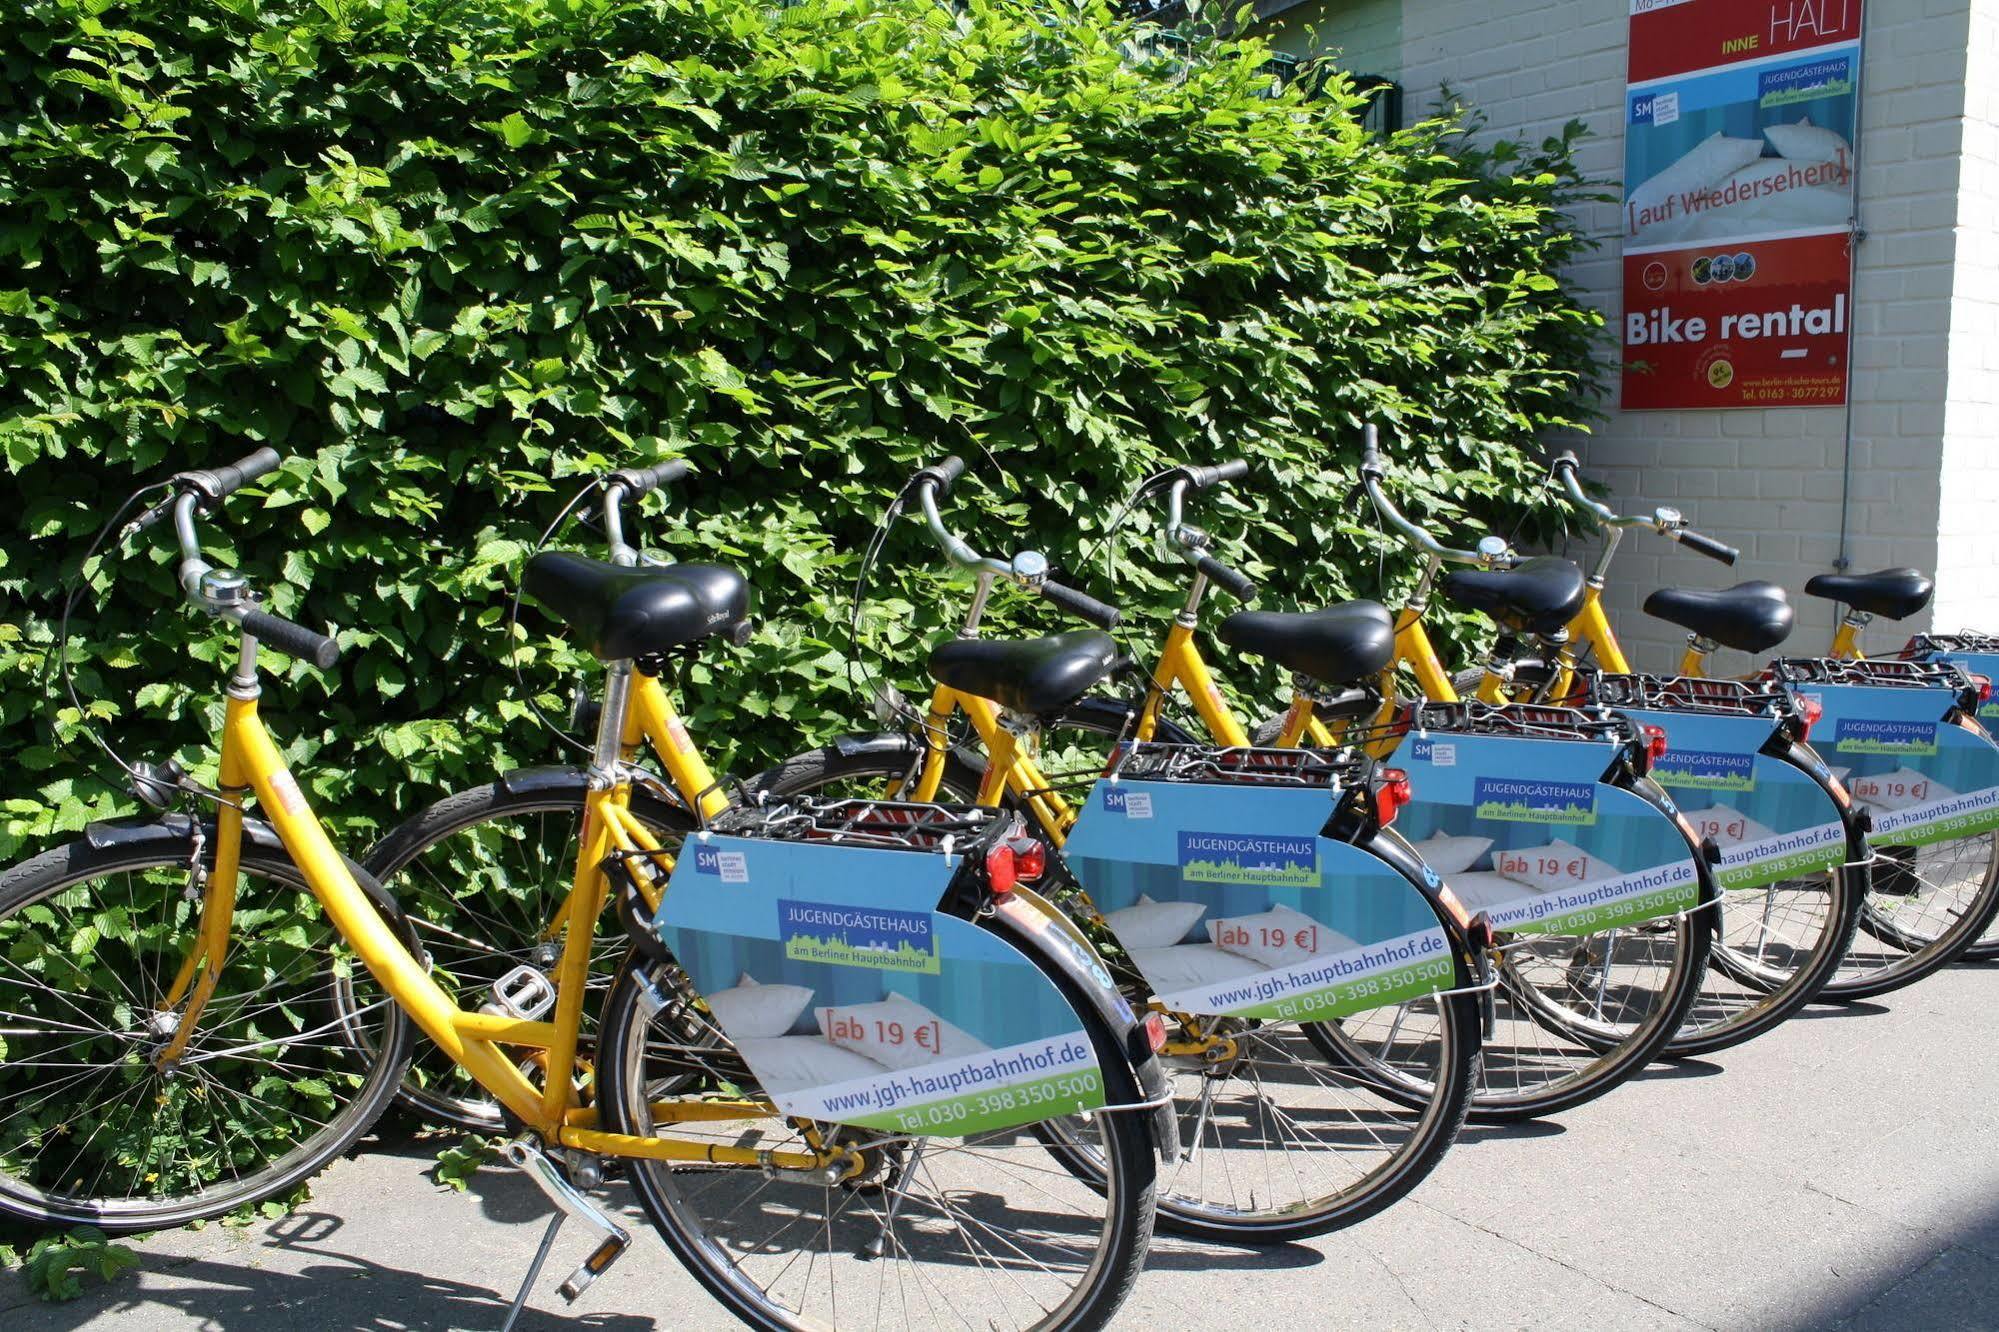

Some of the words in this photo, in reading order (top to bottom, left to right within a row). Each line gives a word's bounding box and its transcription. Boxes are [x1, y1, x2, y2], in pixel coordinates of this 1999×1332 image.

[1722, 35, 1759, 54] INNE
[1635, 101, 1651, 117] SM
[1629, 195, 1675, 236] [auf
[1681, 148, 1848, 214] Wiedersehen]
[1627, 307, 1706, 345] Bike
[1721, 294, 1845, 340] rental
[1742, 389, 1756, 400] Tel.
[1415, 744, 1430, 755] SM
[1106, 794, 1124, 806] SM
[1482, 783, 1591, 799] JUGENDGÄSTEHAUS
[1855, 779, 1879, 799] [ab
[1887, 783, 1904, 797] 19
[1911, 781, 1928, 800] €]
[1529, 810, 1585, 822] Hauptbahnhof
[1888, 833, 1909, 844] Tel.
[1911, 824, 1935, 840] 030
[1942, 818, 1967, 832] 398
[1969, 811, 1993, 826] 350
[1700, 821, 1719, 837] 19
[1727, 820, 1744, 840] €]
[1187, 837, 1312, 855] JUGENDGÄSTEHAUS
[698, 852, 716, 867] SM
[1498, 852, 1528, 877] [ab
[1538, 858, 1559, 875] 19
[1566, 856, 1588, 880] €]
[1726, 868, 1753, 883] 030
[1761, 861, 1788, 876] 398
[1790, 853, 1815, 869] 350
[1817, 846, 1844, 861] 500
[1190, 870, 1203, 878] am
[1206, 868, 1240, 880] Berliner
[1243, 871, 1309, 883] Hauptbahnhof
[788, 907, 928, 935] JUGENDGÄSTEHAUS
[1543, 918, 1567, 934] Tel.
[1568, 911, 1597, 928] 030
[1607, 903, 1633, 920] 398
[1637, 895, 1664, 912] 350
[1667, 887, 1695, 904] 500
[1216, 920, 1249, 948] [ab
[1260, 927, 1285, 947] 19
[1294, 925, 1317, 953] €]
[793, 946, 809, 956] am
[812, 947, 849, 961] Berliner
[852, 951, 926, 969] Hauptbahnhof
[1208, 936, 1444, 1008] www.jgh-hauptbahnhof.de
[1274, 1001, 1302, 1018] Tel.
[1303, 991, 1336, 1012] 030
[1349, 981, 1380, 1001] 398
[1383, 970, 1415, 990] 350
[1415, 960, 1450, 980] 500
[826, 1008, 864, 1042] [ab
[876, 1020, 904, 1045] 19
[913, 1020, 940, 1054] €]
[823, 1042, 1088, 1113] www.jgh-hauptbahnhof.de
[896, 1110, 928, 1131] Tel.
[928, 1102, 966, 1126] 030
[979, 1092, 1016, 1116] 398
[1016, 1083, 1056, 1107] 350
[1057, 1074, 1098, 1097] 500
